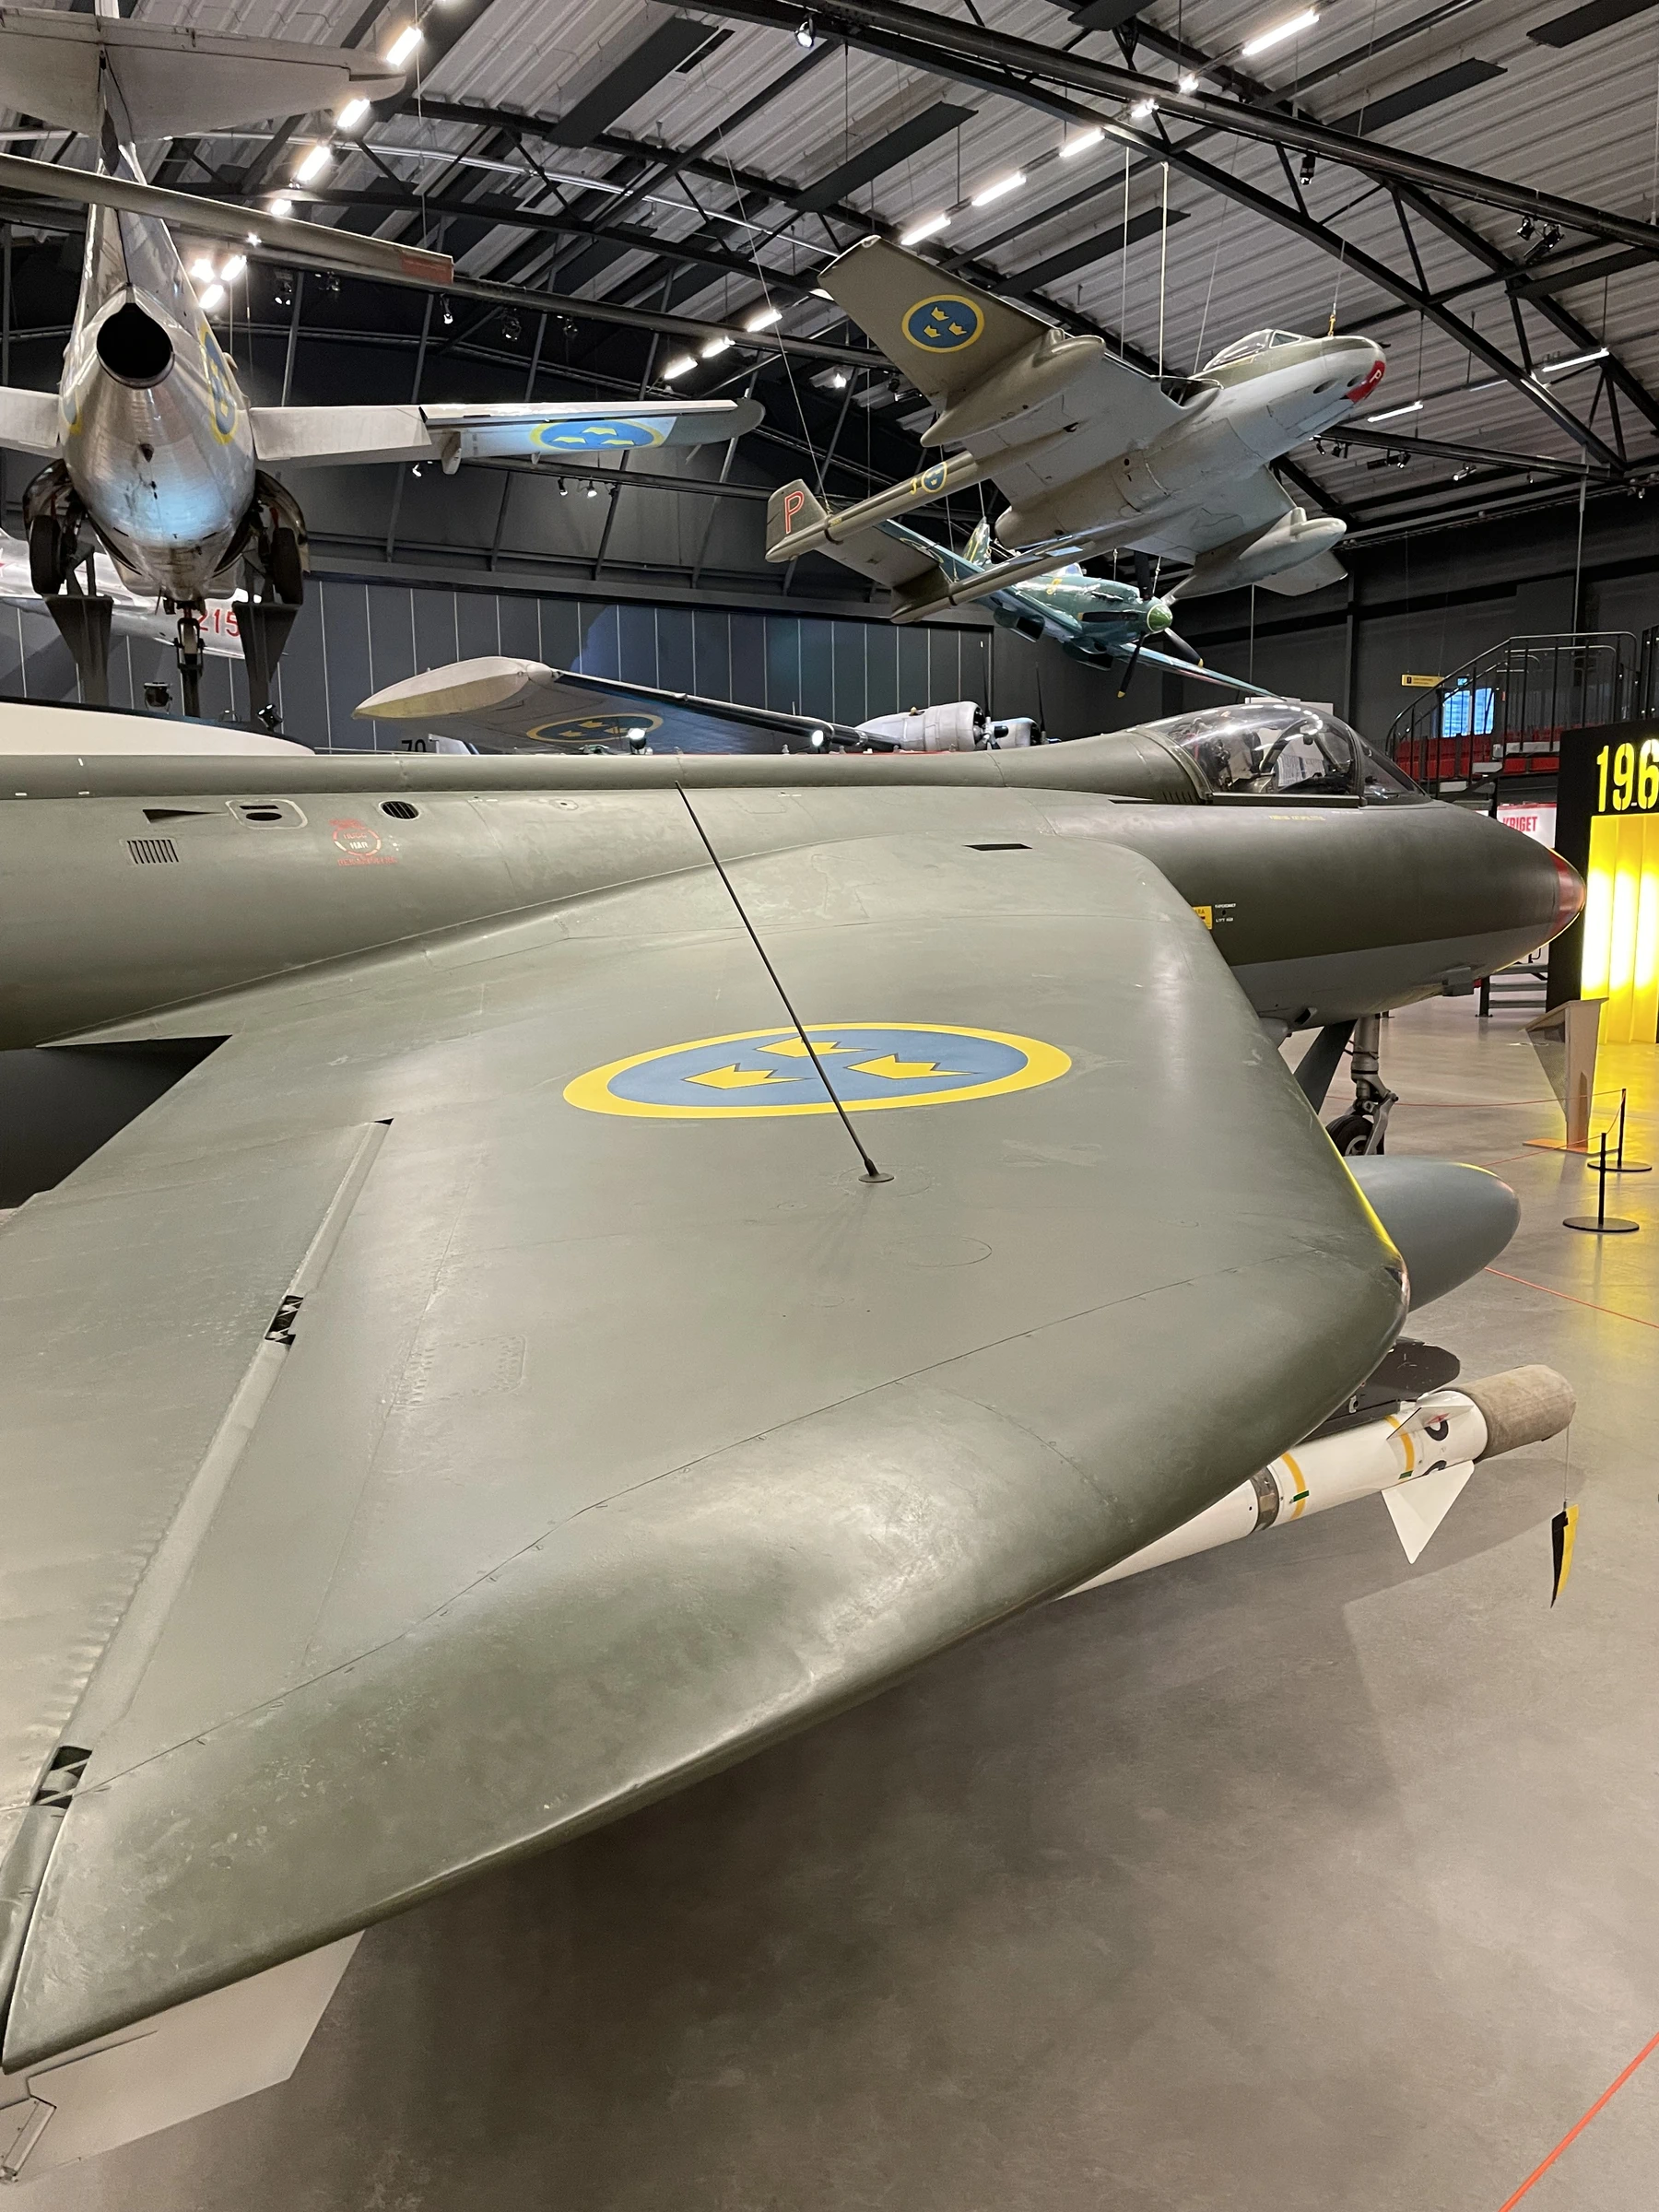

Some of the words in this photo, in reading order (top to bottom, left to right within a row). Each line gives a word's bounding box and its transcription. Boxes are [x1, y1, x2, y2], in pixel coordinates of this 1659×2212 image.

[1369, 369, 1382, 383] P
[784, 490, 805, 535] P
[1596, 738, 1659, 812] 196
